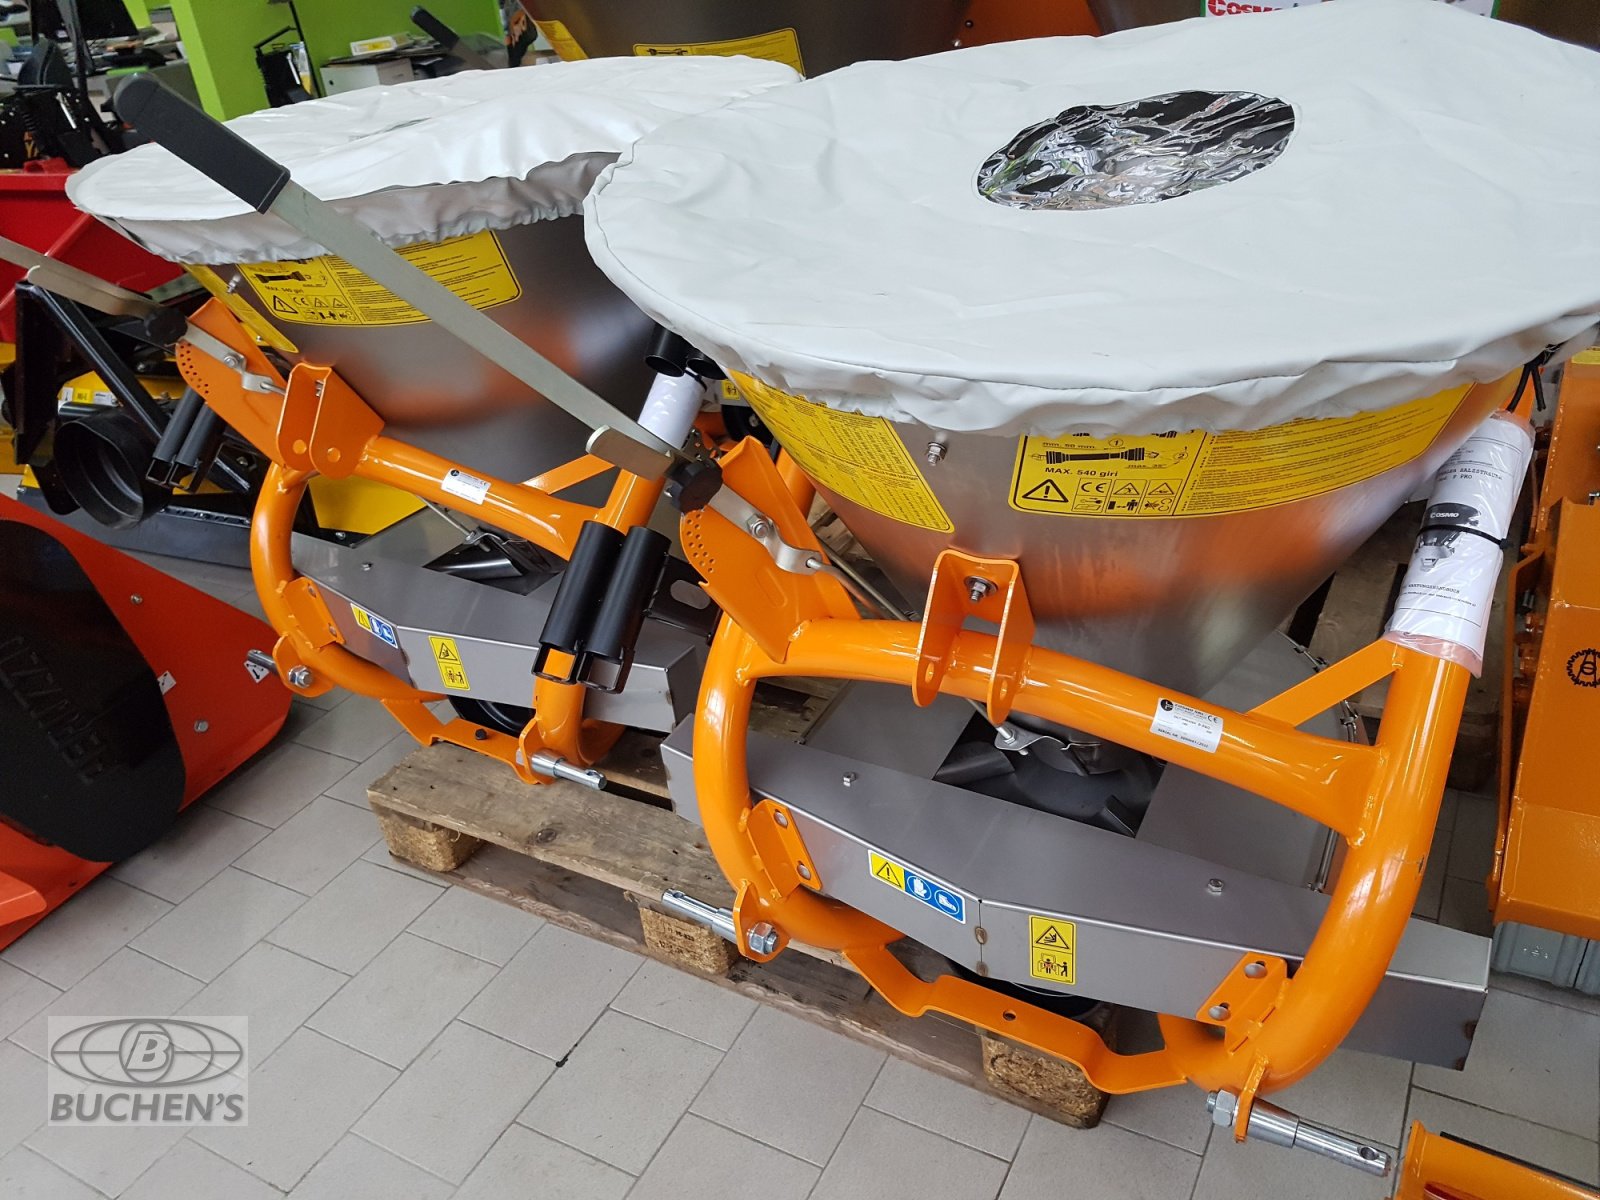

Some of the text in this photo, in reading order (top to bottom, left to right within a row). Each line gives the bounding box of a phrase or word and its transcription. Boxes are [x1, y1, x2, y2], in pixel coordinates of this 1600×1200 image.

[1208, 0, 1283, 16] COSM
[1045, 467, 1073, 475] MAX.
[1099, 470, 1118, 478] giri
